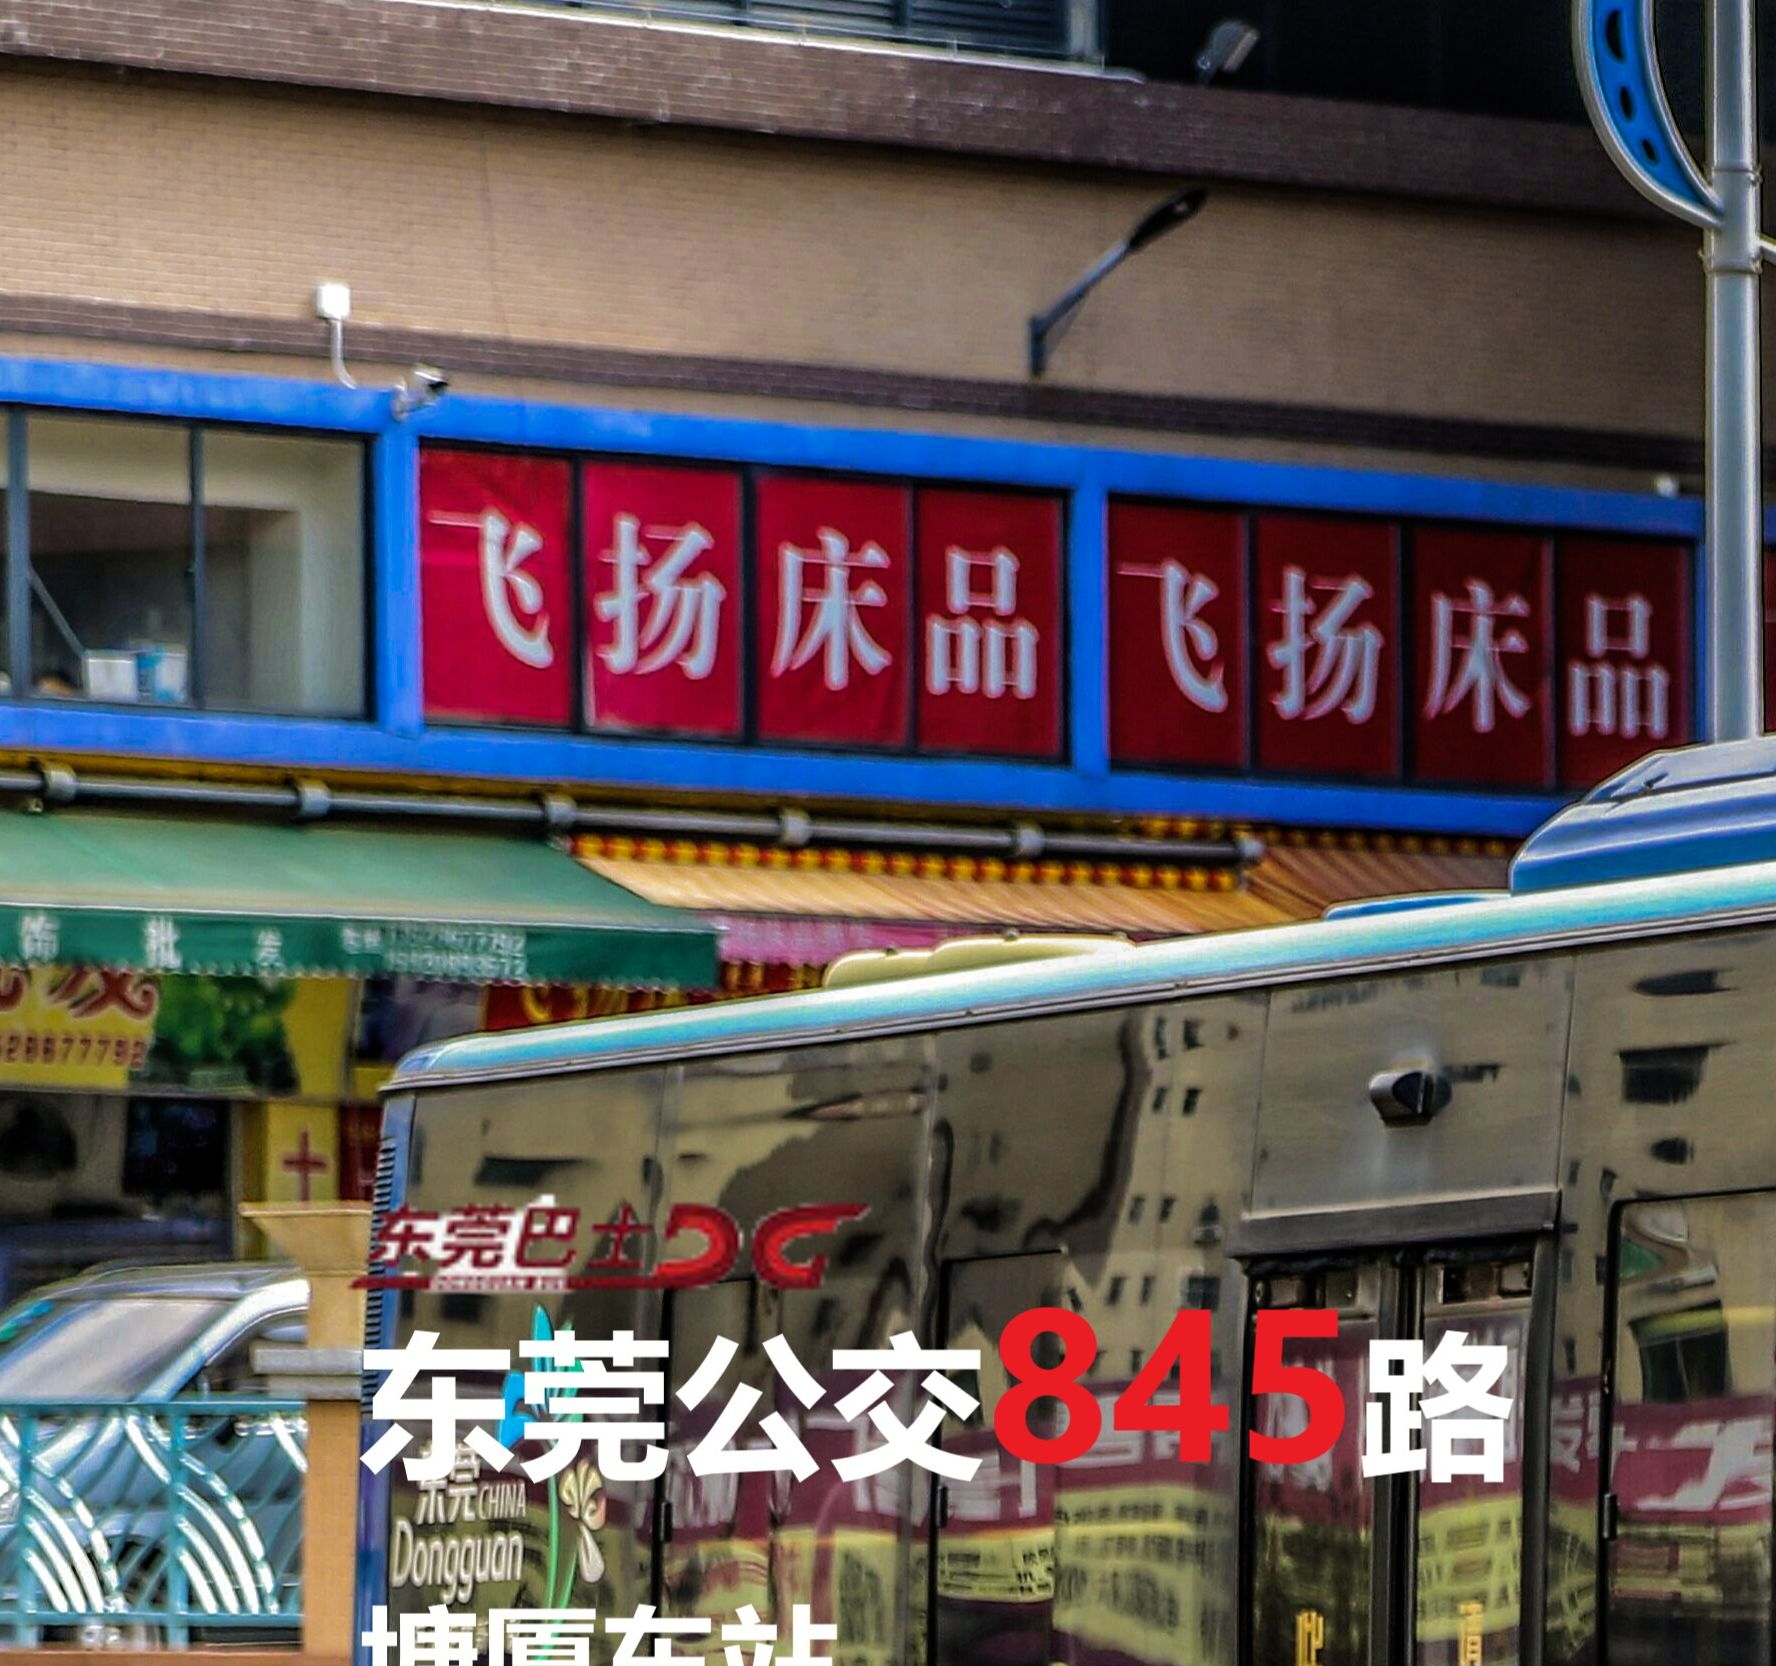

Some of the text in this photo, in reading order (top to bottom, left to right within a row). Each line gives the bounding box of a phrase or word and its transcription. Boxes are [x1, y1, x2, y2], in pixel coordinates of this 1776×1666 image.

[428, 508, 1038, 700] 飞扬床品
[1116, 557, 1672, 741] 飞扬床品
[391, 1516, 525, 1605] Dongguan
[477, 1480, 527, 1520] CHINA
